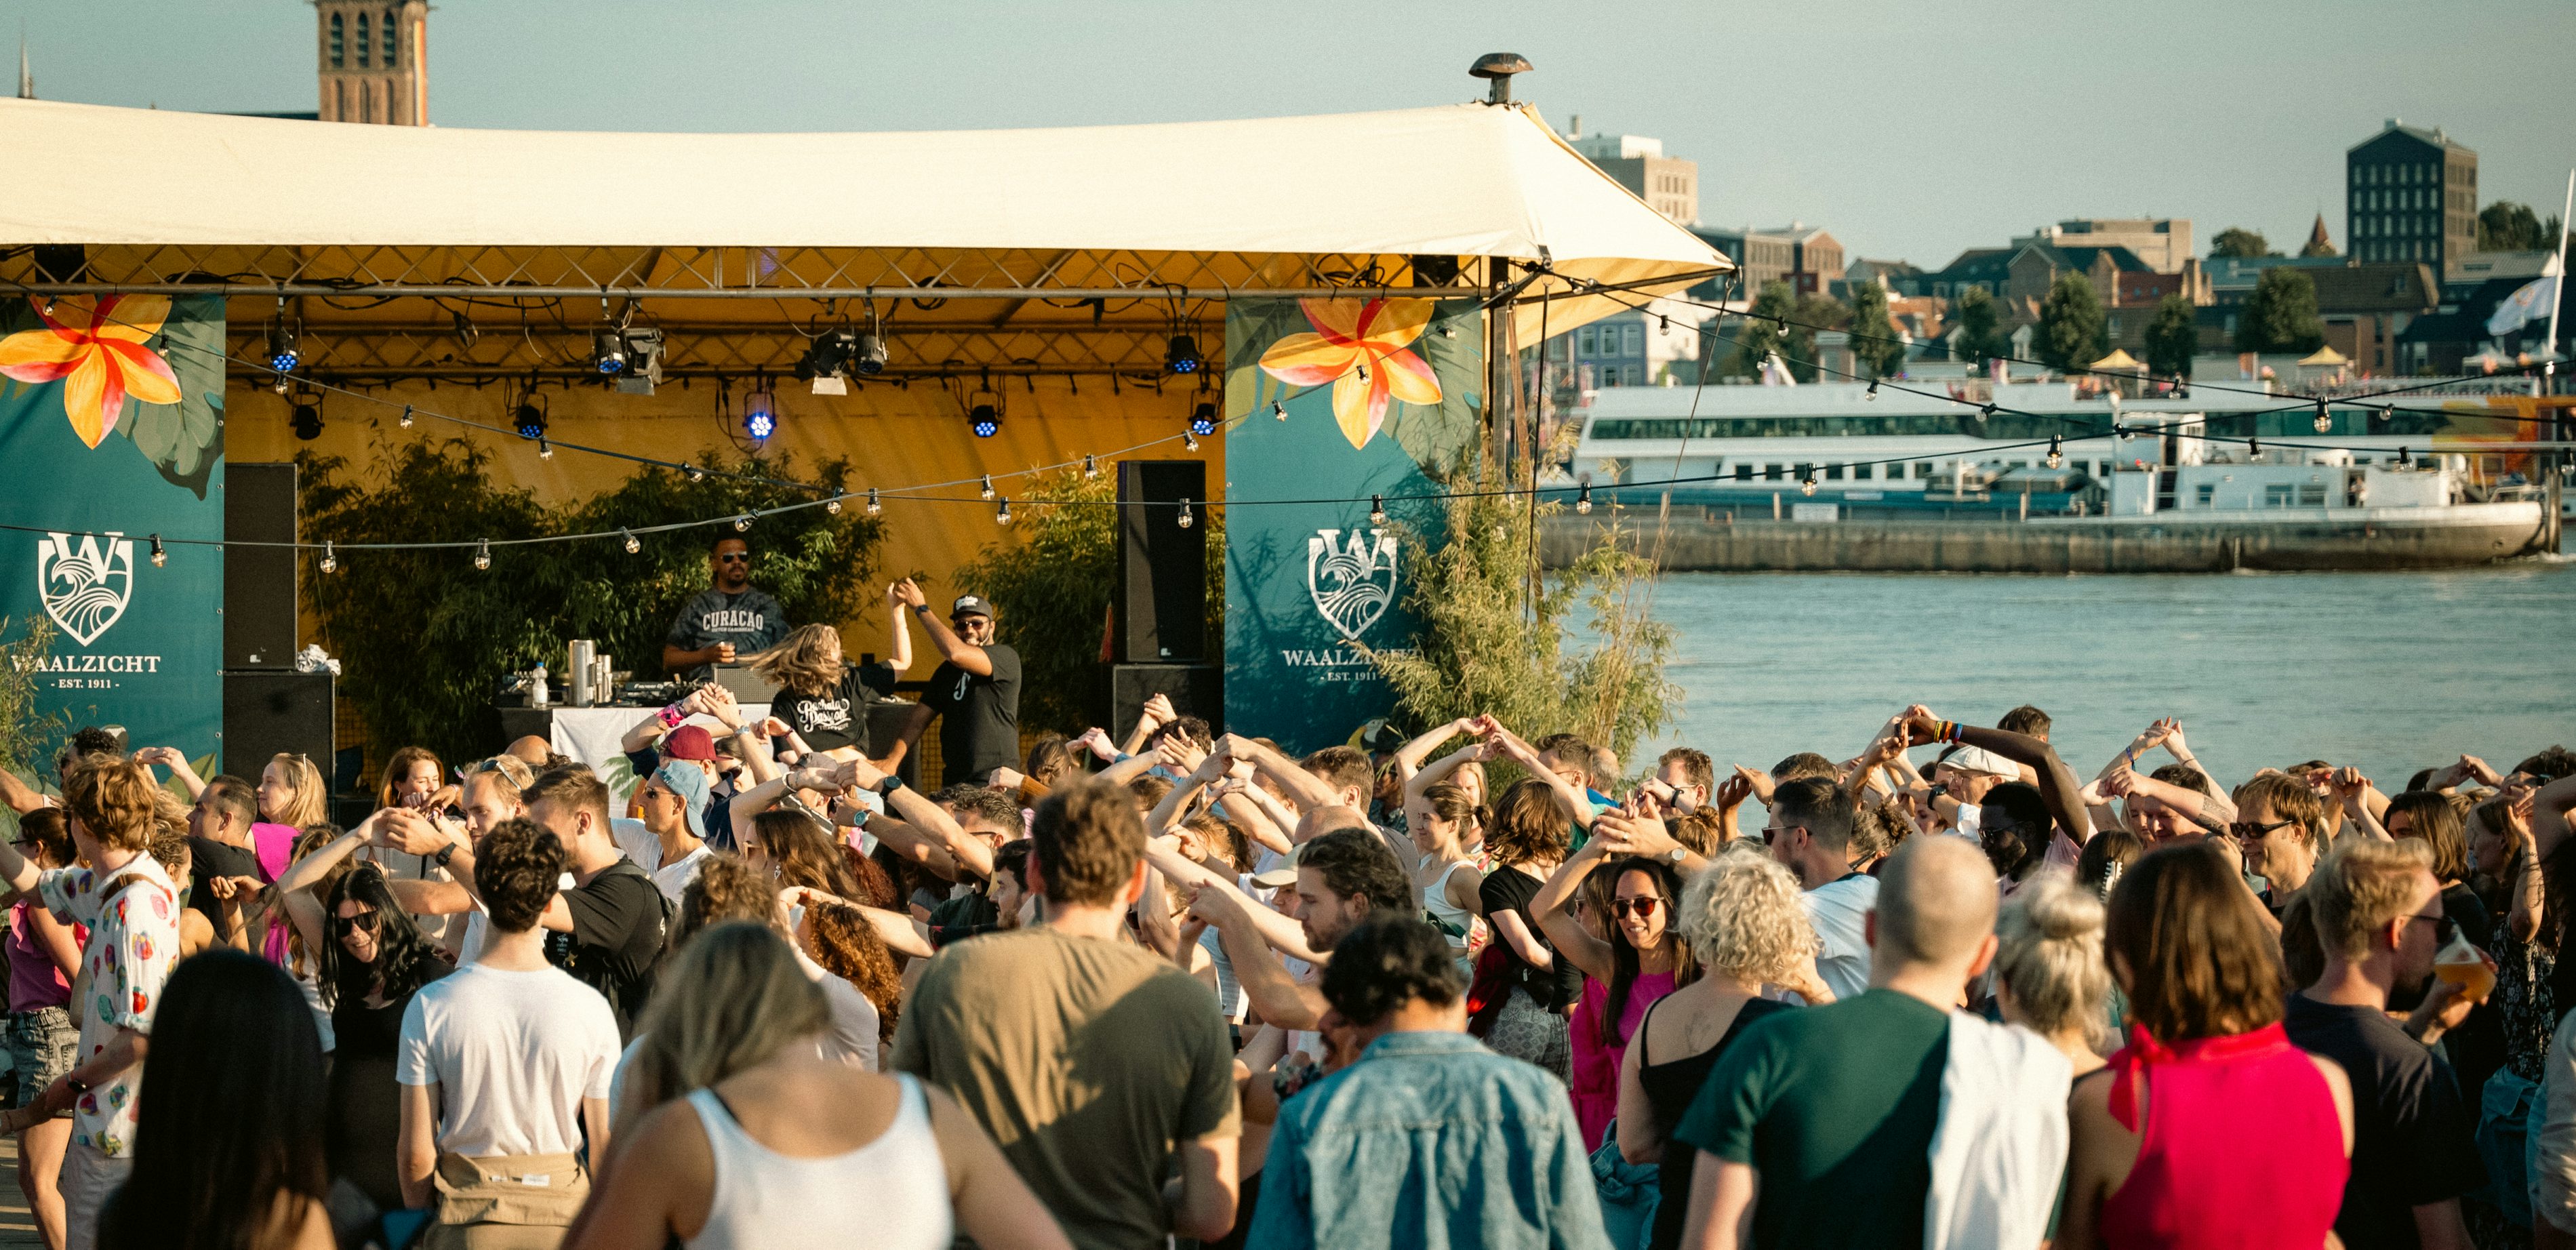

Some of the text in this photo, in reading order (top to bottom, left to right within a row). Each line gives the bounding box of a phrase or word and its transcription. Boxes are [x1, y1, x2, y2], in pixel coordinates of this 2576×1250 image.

[702, 610, 763, 631] CURACAO
[10, 656, 161, 672] WAALZICHT
[1327, 672, 1350, 681] EST.
[1355, 672, 1376, 681] 1911
[58, 679, 83, 689] EST.
[88, 679, 111, 689] 1911
